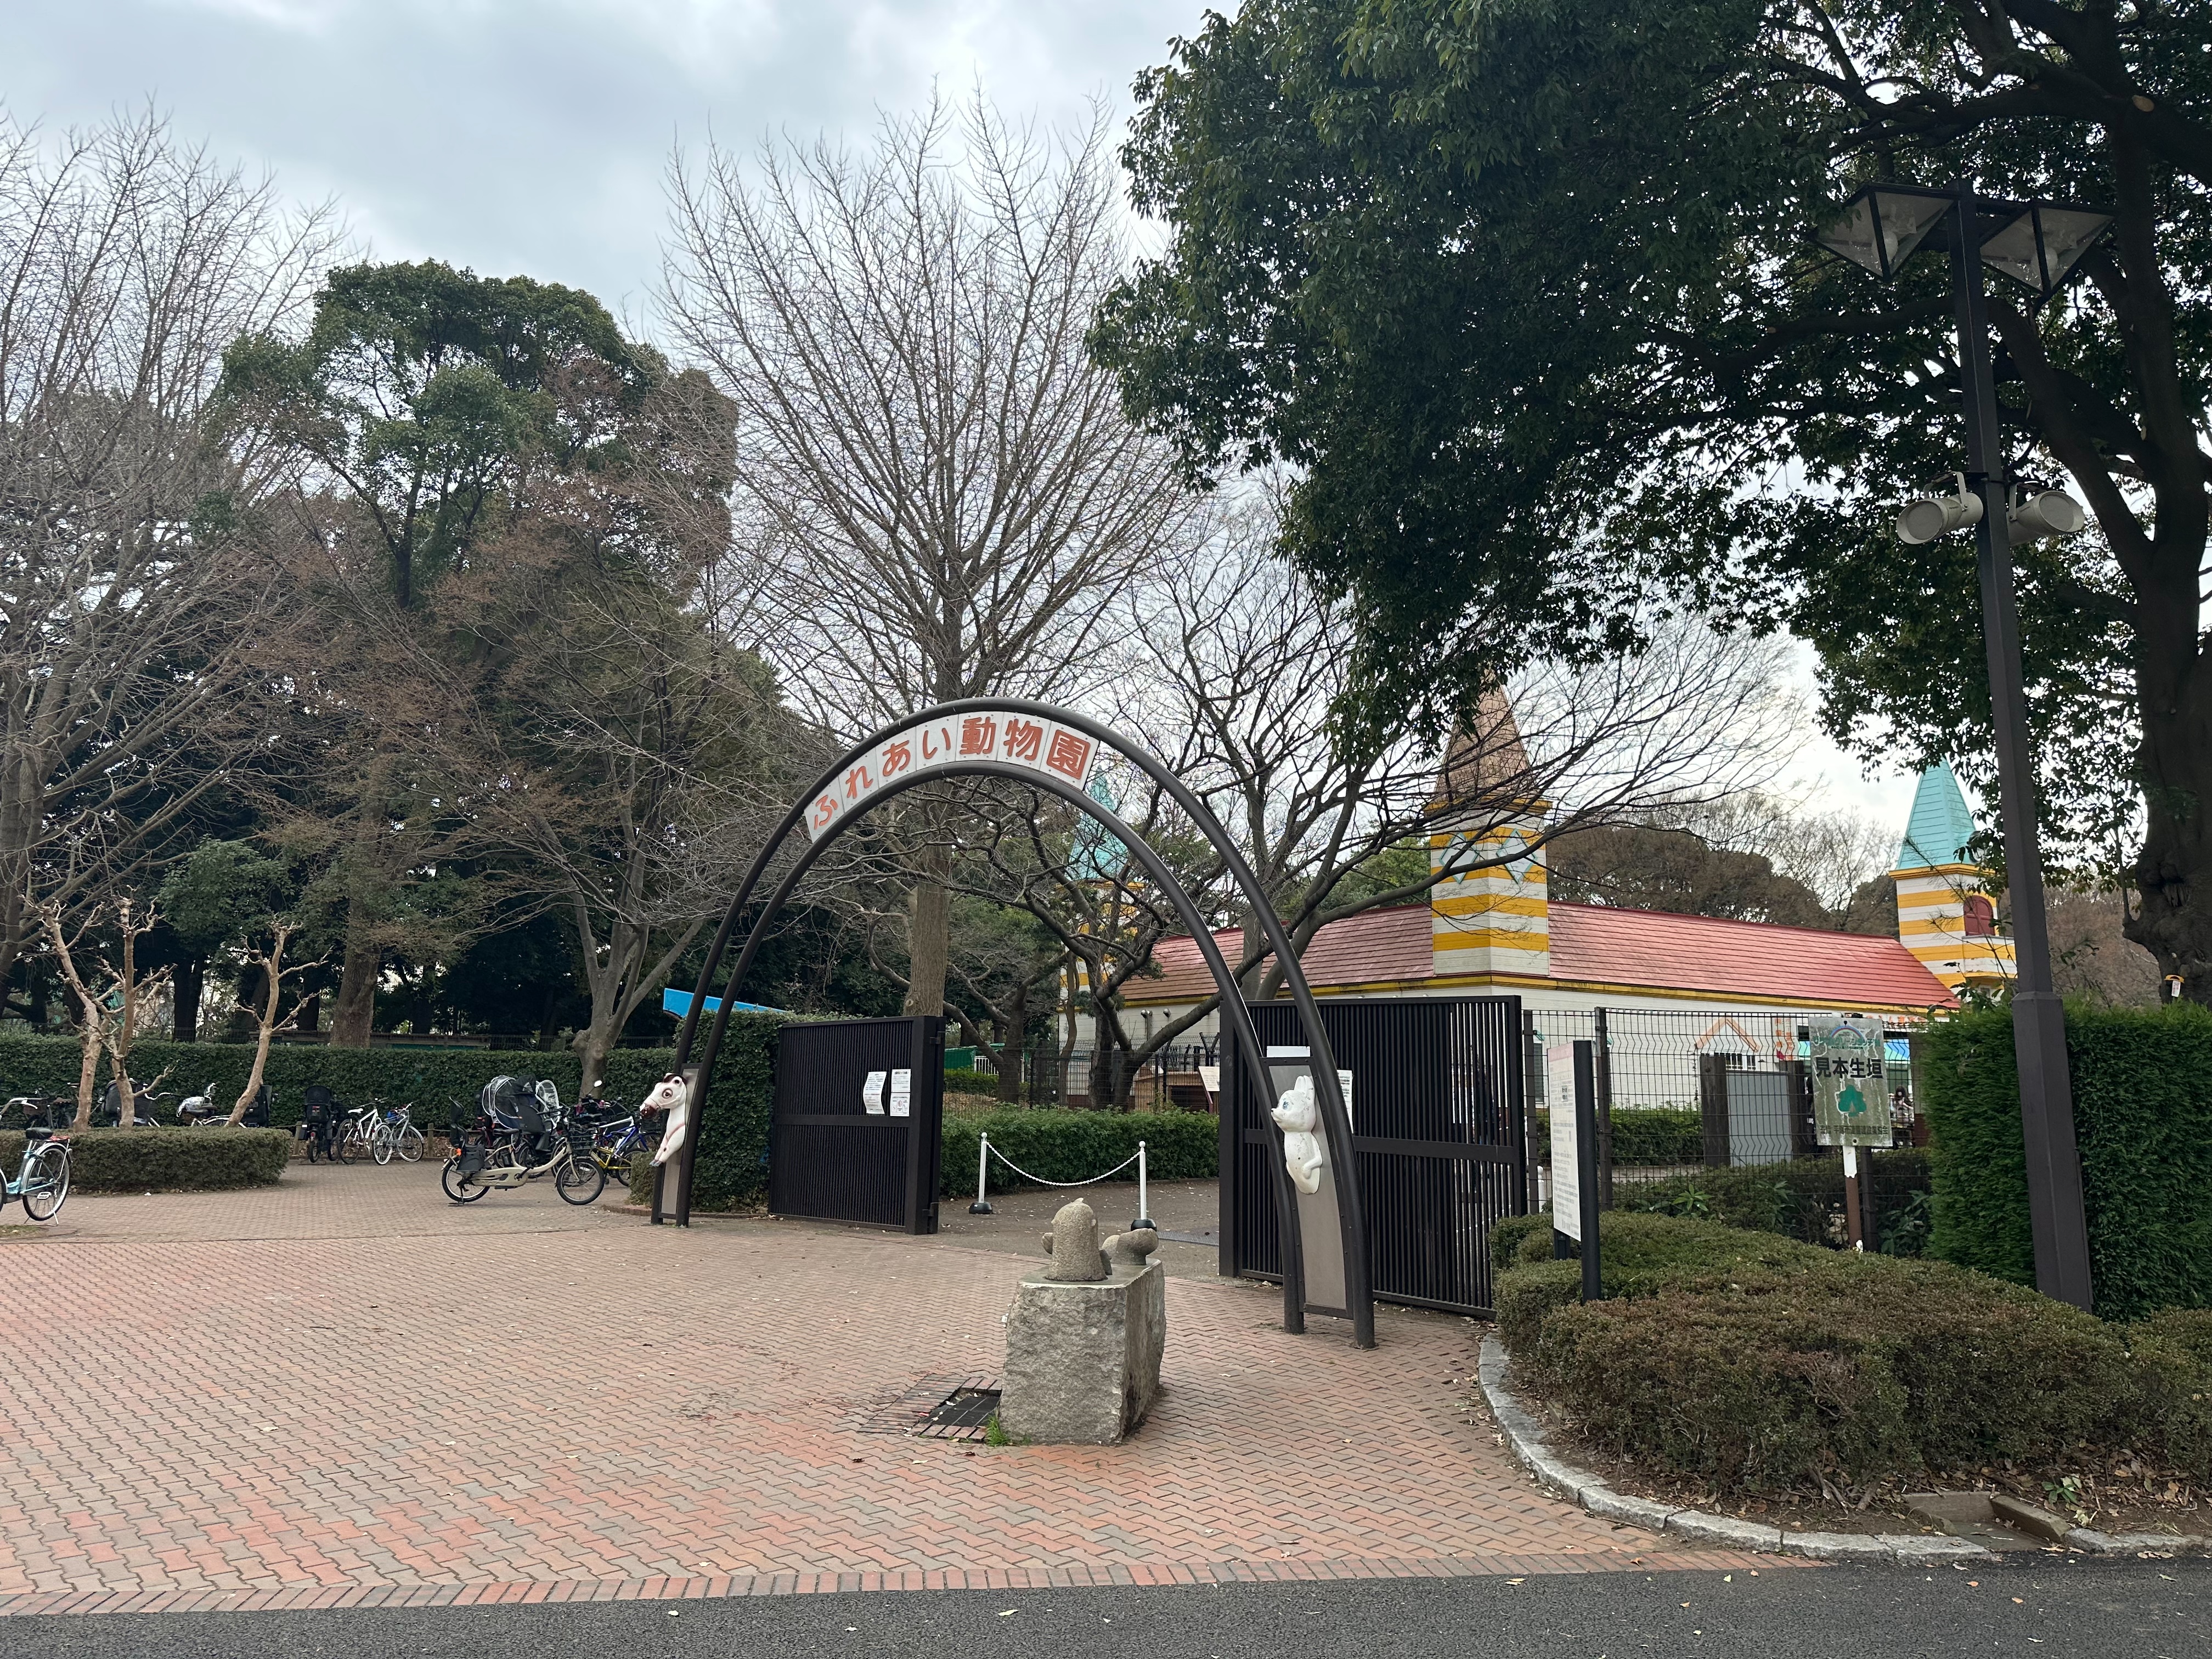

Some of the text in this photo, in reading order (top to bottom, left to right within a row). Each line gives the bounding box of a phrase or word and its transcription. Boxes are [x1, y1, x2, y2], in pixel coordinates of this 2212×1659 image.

[813, 716, 1091, 830] ふれあい動物園
[1816, 1057, 1883, 1079] 見本生垣
